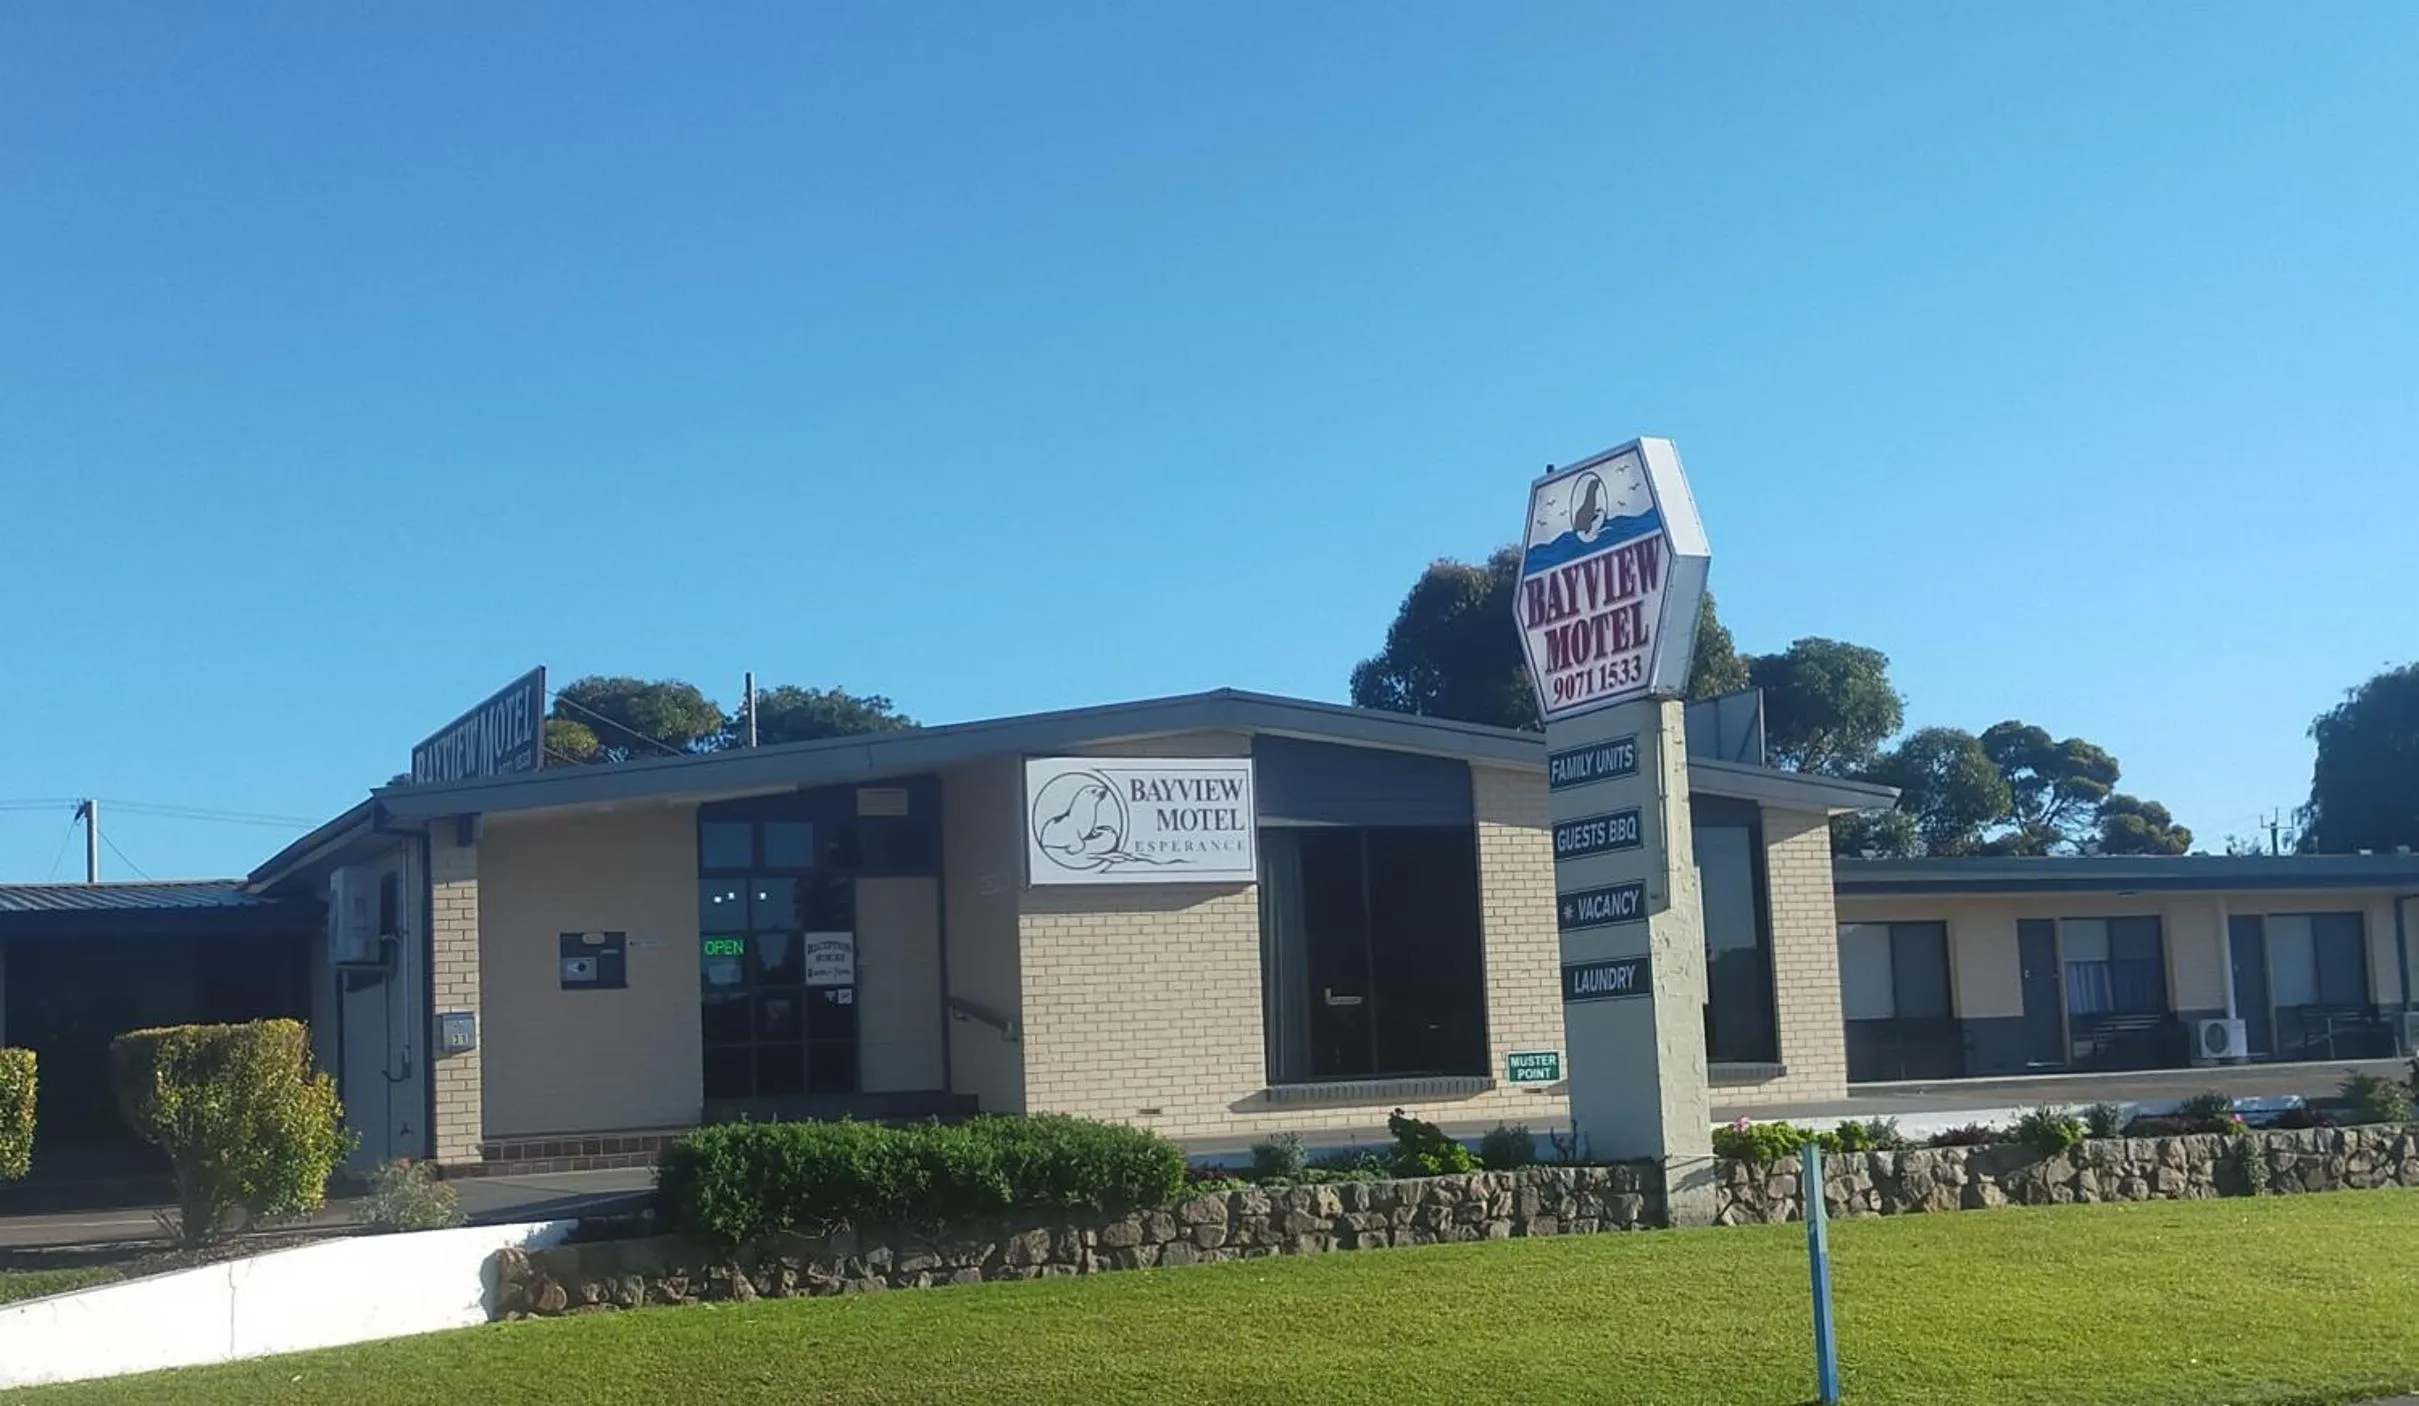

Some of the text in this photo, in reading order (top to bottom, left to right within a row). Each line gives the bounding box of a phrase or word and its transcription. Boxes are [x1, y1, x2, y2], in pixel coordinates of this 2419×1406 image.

[1525, 534, 1660, 630] BAYVIEW
[1545, 600, 1649, 675] MOTEL
[479, 685, 532, 778] MOTEL
[1551, 743, 1634, 784] FAMILY UNITS
[1130, 778, 1244, 802] BAYVIEW
[1157, 808, 1245, 832] MOTEL
[1556, 814, 1637, 852] GUESTS BBQ
[1135, 839, 1245, 853] ESPERANCE
[1577, 889, 1640, 921] VACANCY
[704, 939, 744, 956] OPEN
[1574, 964, 1637, 994] LAUNDRY
[1510, 1054, 1557, 1067] MUSTER
[1517, 1067, 1551, 1080] POINT
